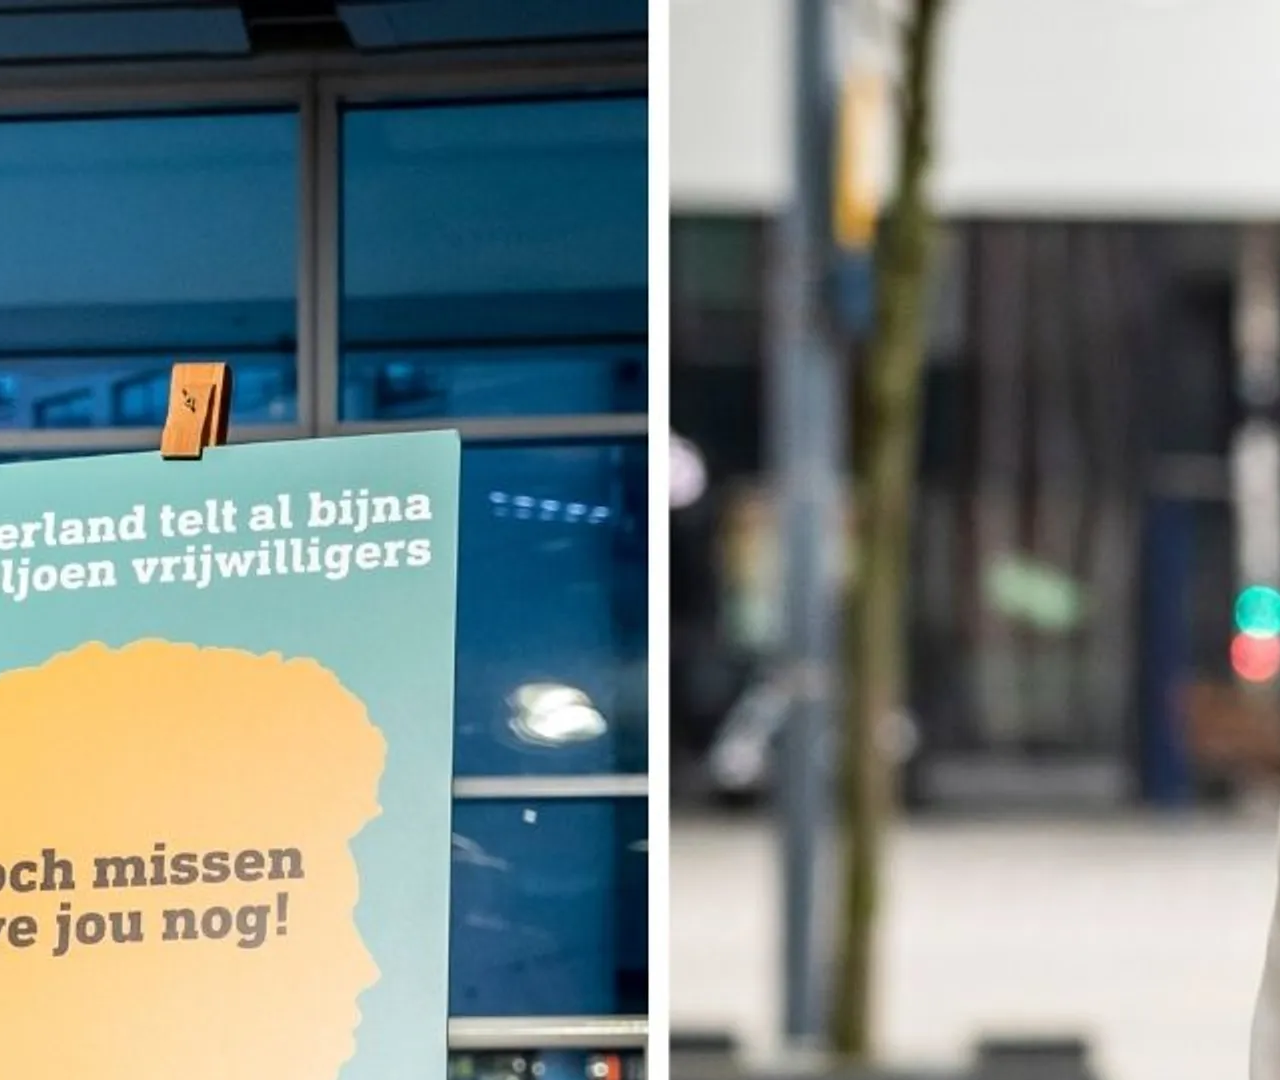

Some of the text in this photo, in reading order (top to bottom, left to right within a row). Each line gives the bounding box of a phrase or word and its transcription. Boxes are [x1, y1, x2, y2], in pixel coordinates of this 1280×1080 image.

[160, 499, 238, 537] telt
[249, 494, 292, 532] al
[308, 489, 433, 533] bijna
[132, 536, 432, 588] vrijwilligers
[93, 843, 305, 888] missen
[52, 902, 143, 956] jou
[163, 892, 289, 948] nog!
